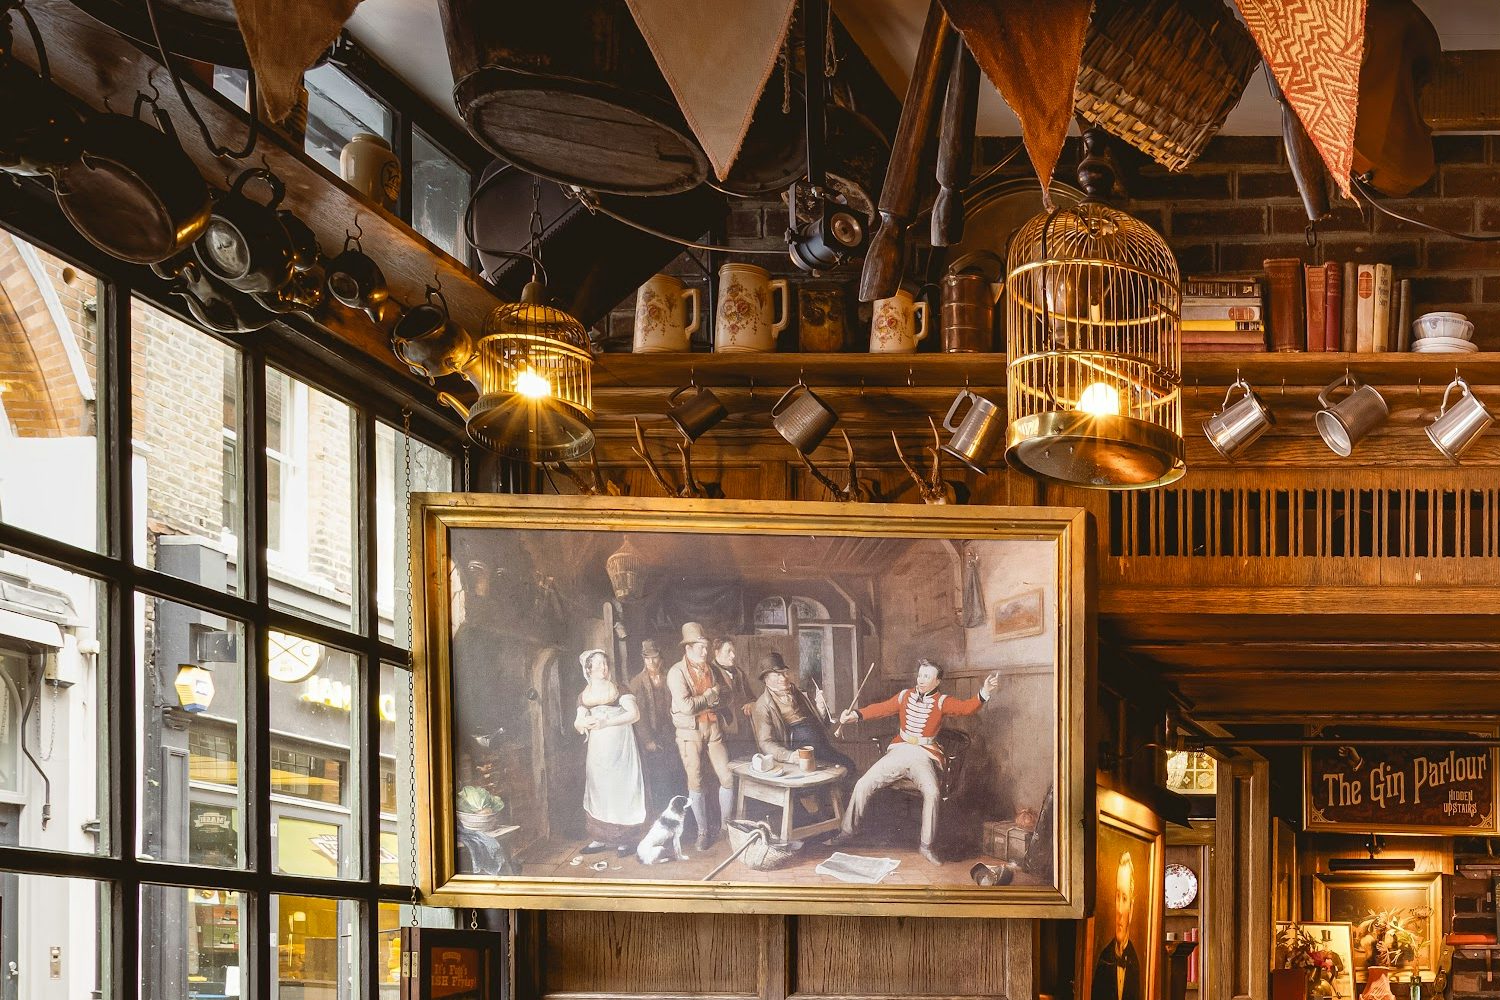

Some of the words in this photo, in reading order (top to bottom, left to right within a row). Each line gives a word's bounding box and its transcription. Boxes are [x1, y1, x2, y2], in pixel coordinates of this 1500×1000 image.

[1323, 773, 1362, 806] The
[1370, 761, 1406, 809] Gin
[1413, 751, 1487, 805] Parlour
[1449, 789, 1473, 804] HIDDEN
[1443, 802, 1477, 817] UPSTAIRS
